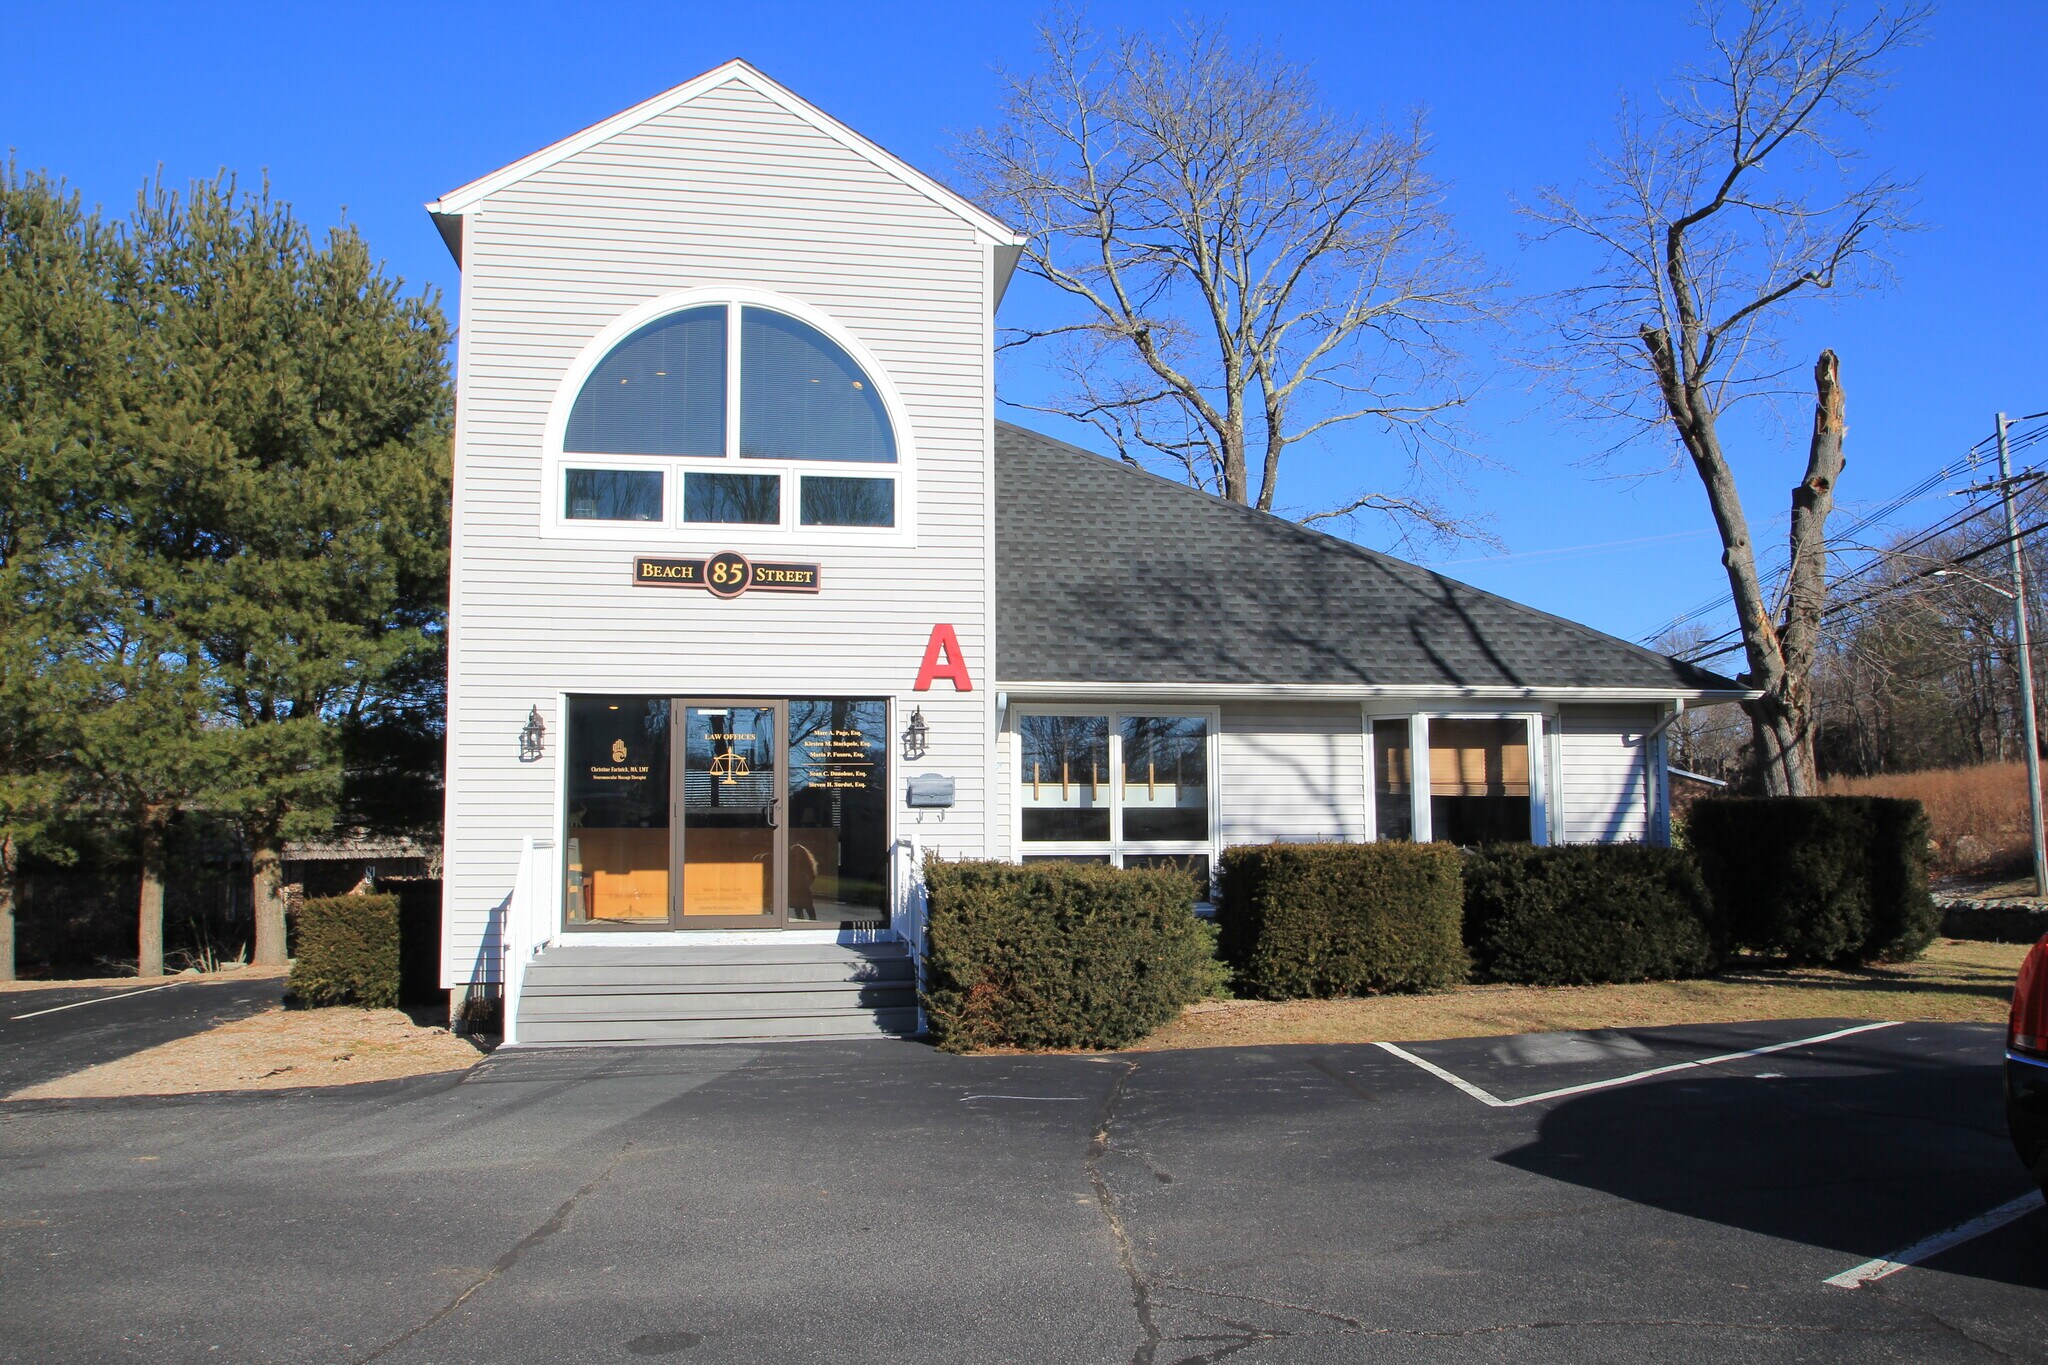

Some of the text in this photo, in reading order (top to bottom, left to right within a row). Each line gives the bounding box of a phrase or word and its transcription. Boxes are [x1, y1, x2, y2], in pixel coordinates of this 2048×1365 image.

[642, 562, 813, 585] BEACH 85 STREET
[912, 623, 973, 692] A
